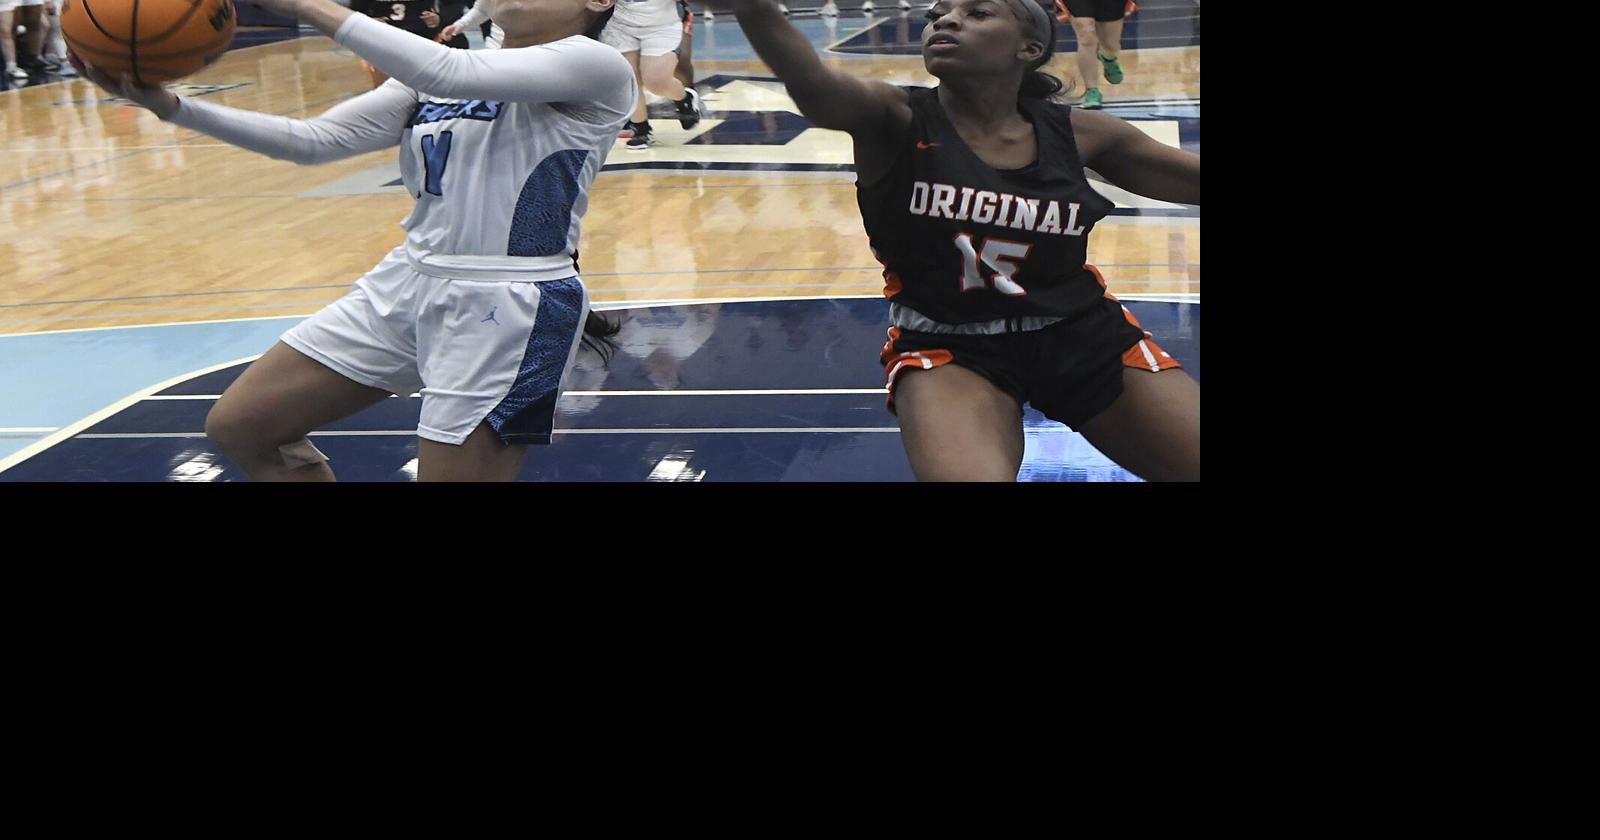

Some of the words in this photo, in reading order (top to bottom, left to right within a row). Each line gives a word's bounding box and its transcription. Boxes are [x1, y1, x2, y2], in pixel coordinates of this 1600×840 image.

[390, 3, 406, 21] 3
[909, 181, 1086, 236] ORIGINAL
[953, 232, 1032, 296] 15
